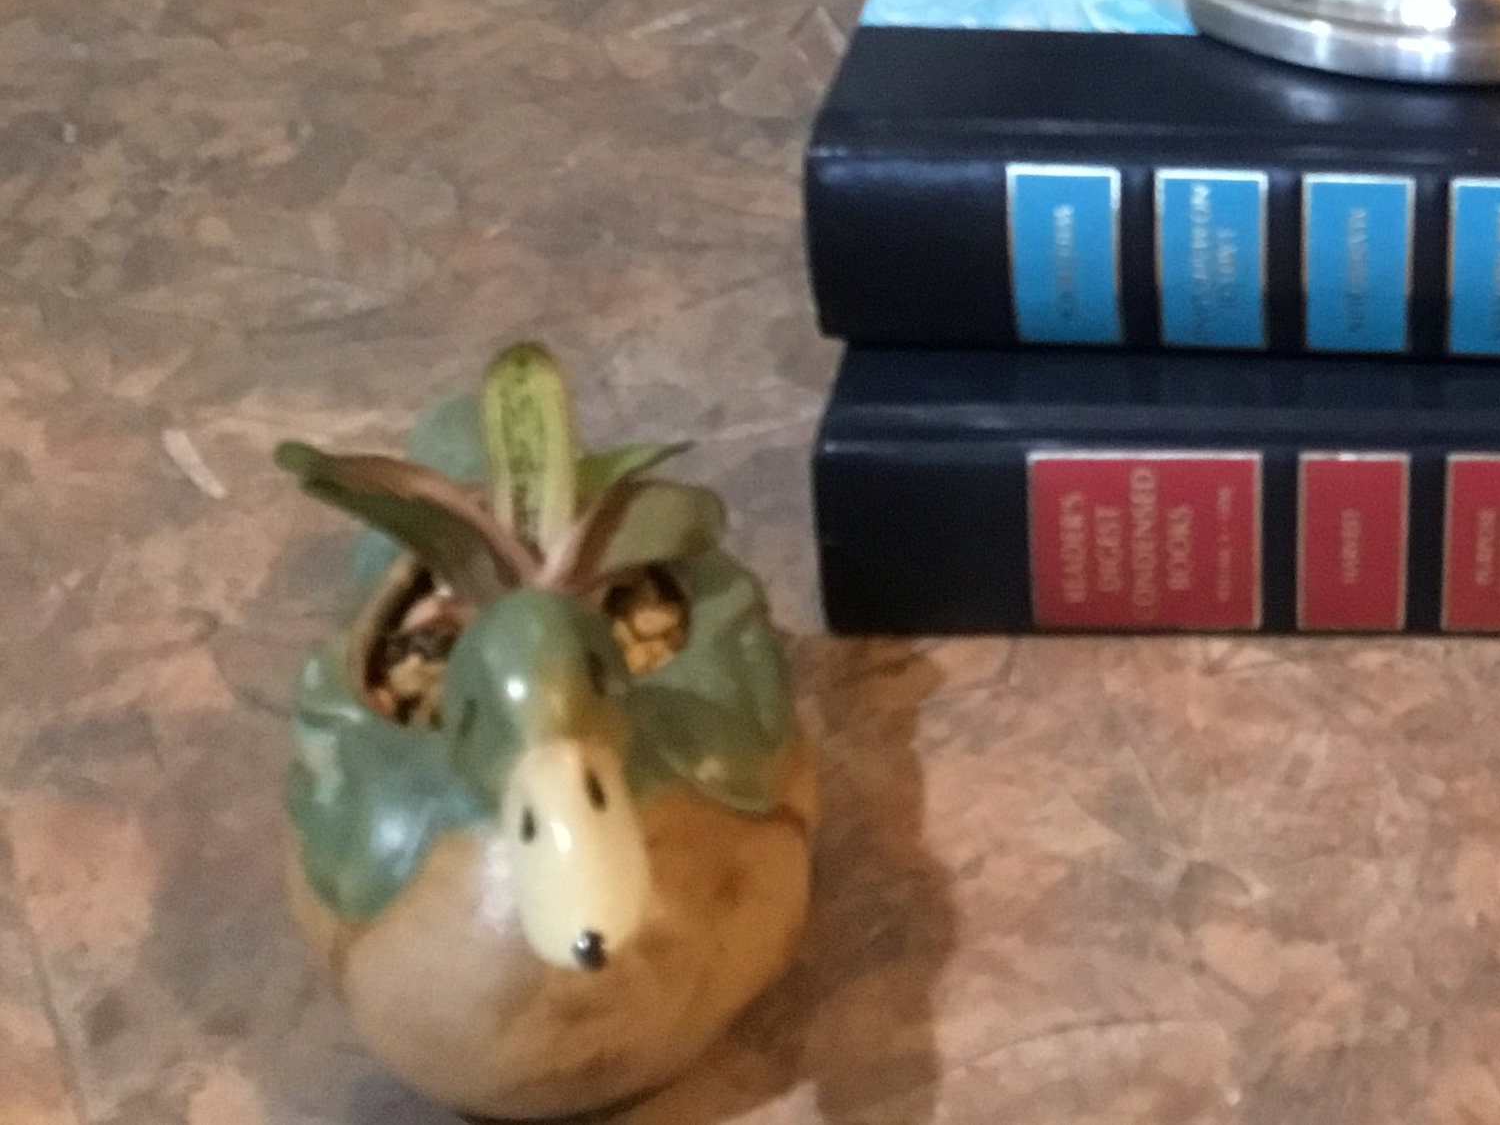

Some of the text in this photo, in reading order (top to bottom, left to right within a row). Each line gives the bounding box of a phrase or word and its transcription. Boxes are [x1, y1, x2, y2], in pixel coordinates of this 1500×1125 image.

[1095, 506, 1122, 592] DIGEST
[1129, 466, 1157, 620] CONDENSED
[1166, 503, 1193, 591] BOOKS
